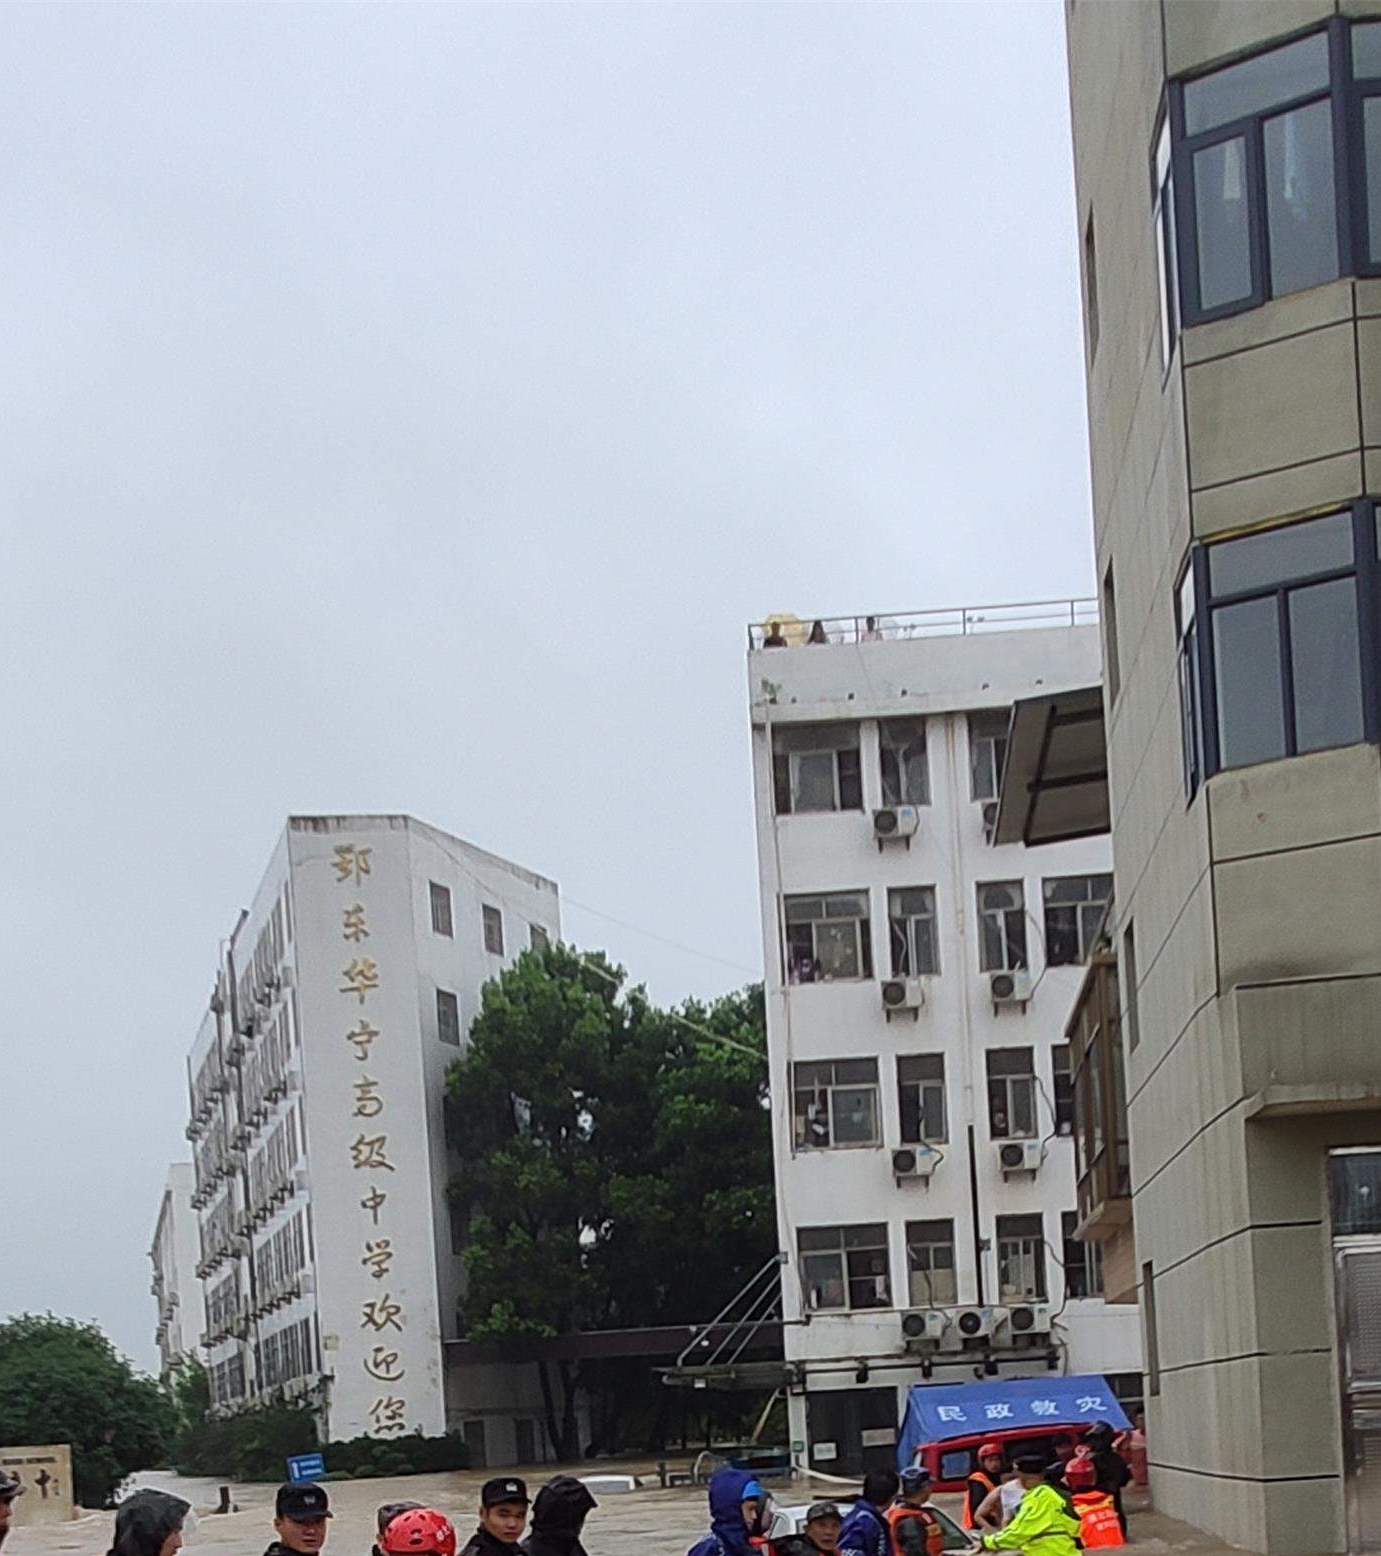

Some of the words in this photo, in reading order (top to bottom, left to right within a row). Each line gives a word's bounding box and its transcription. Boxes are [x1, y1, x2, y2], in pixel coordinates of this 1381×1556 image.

[331, 843, 406, 1434] 鄂东华宁高级中学欢迎您
[937, 1396, 1107, 1422] 民政救灾
